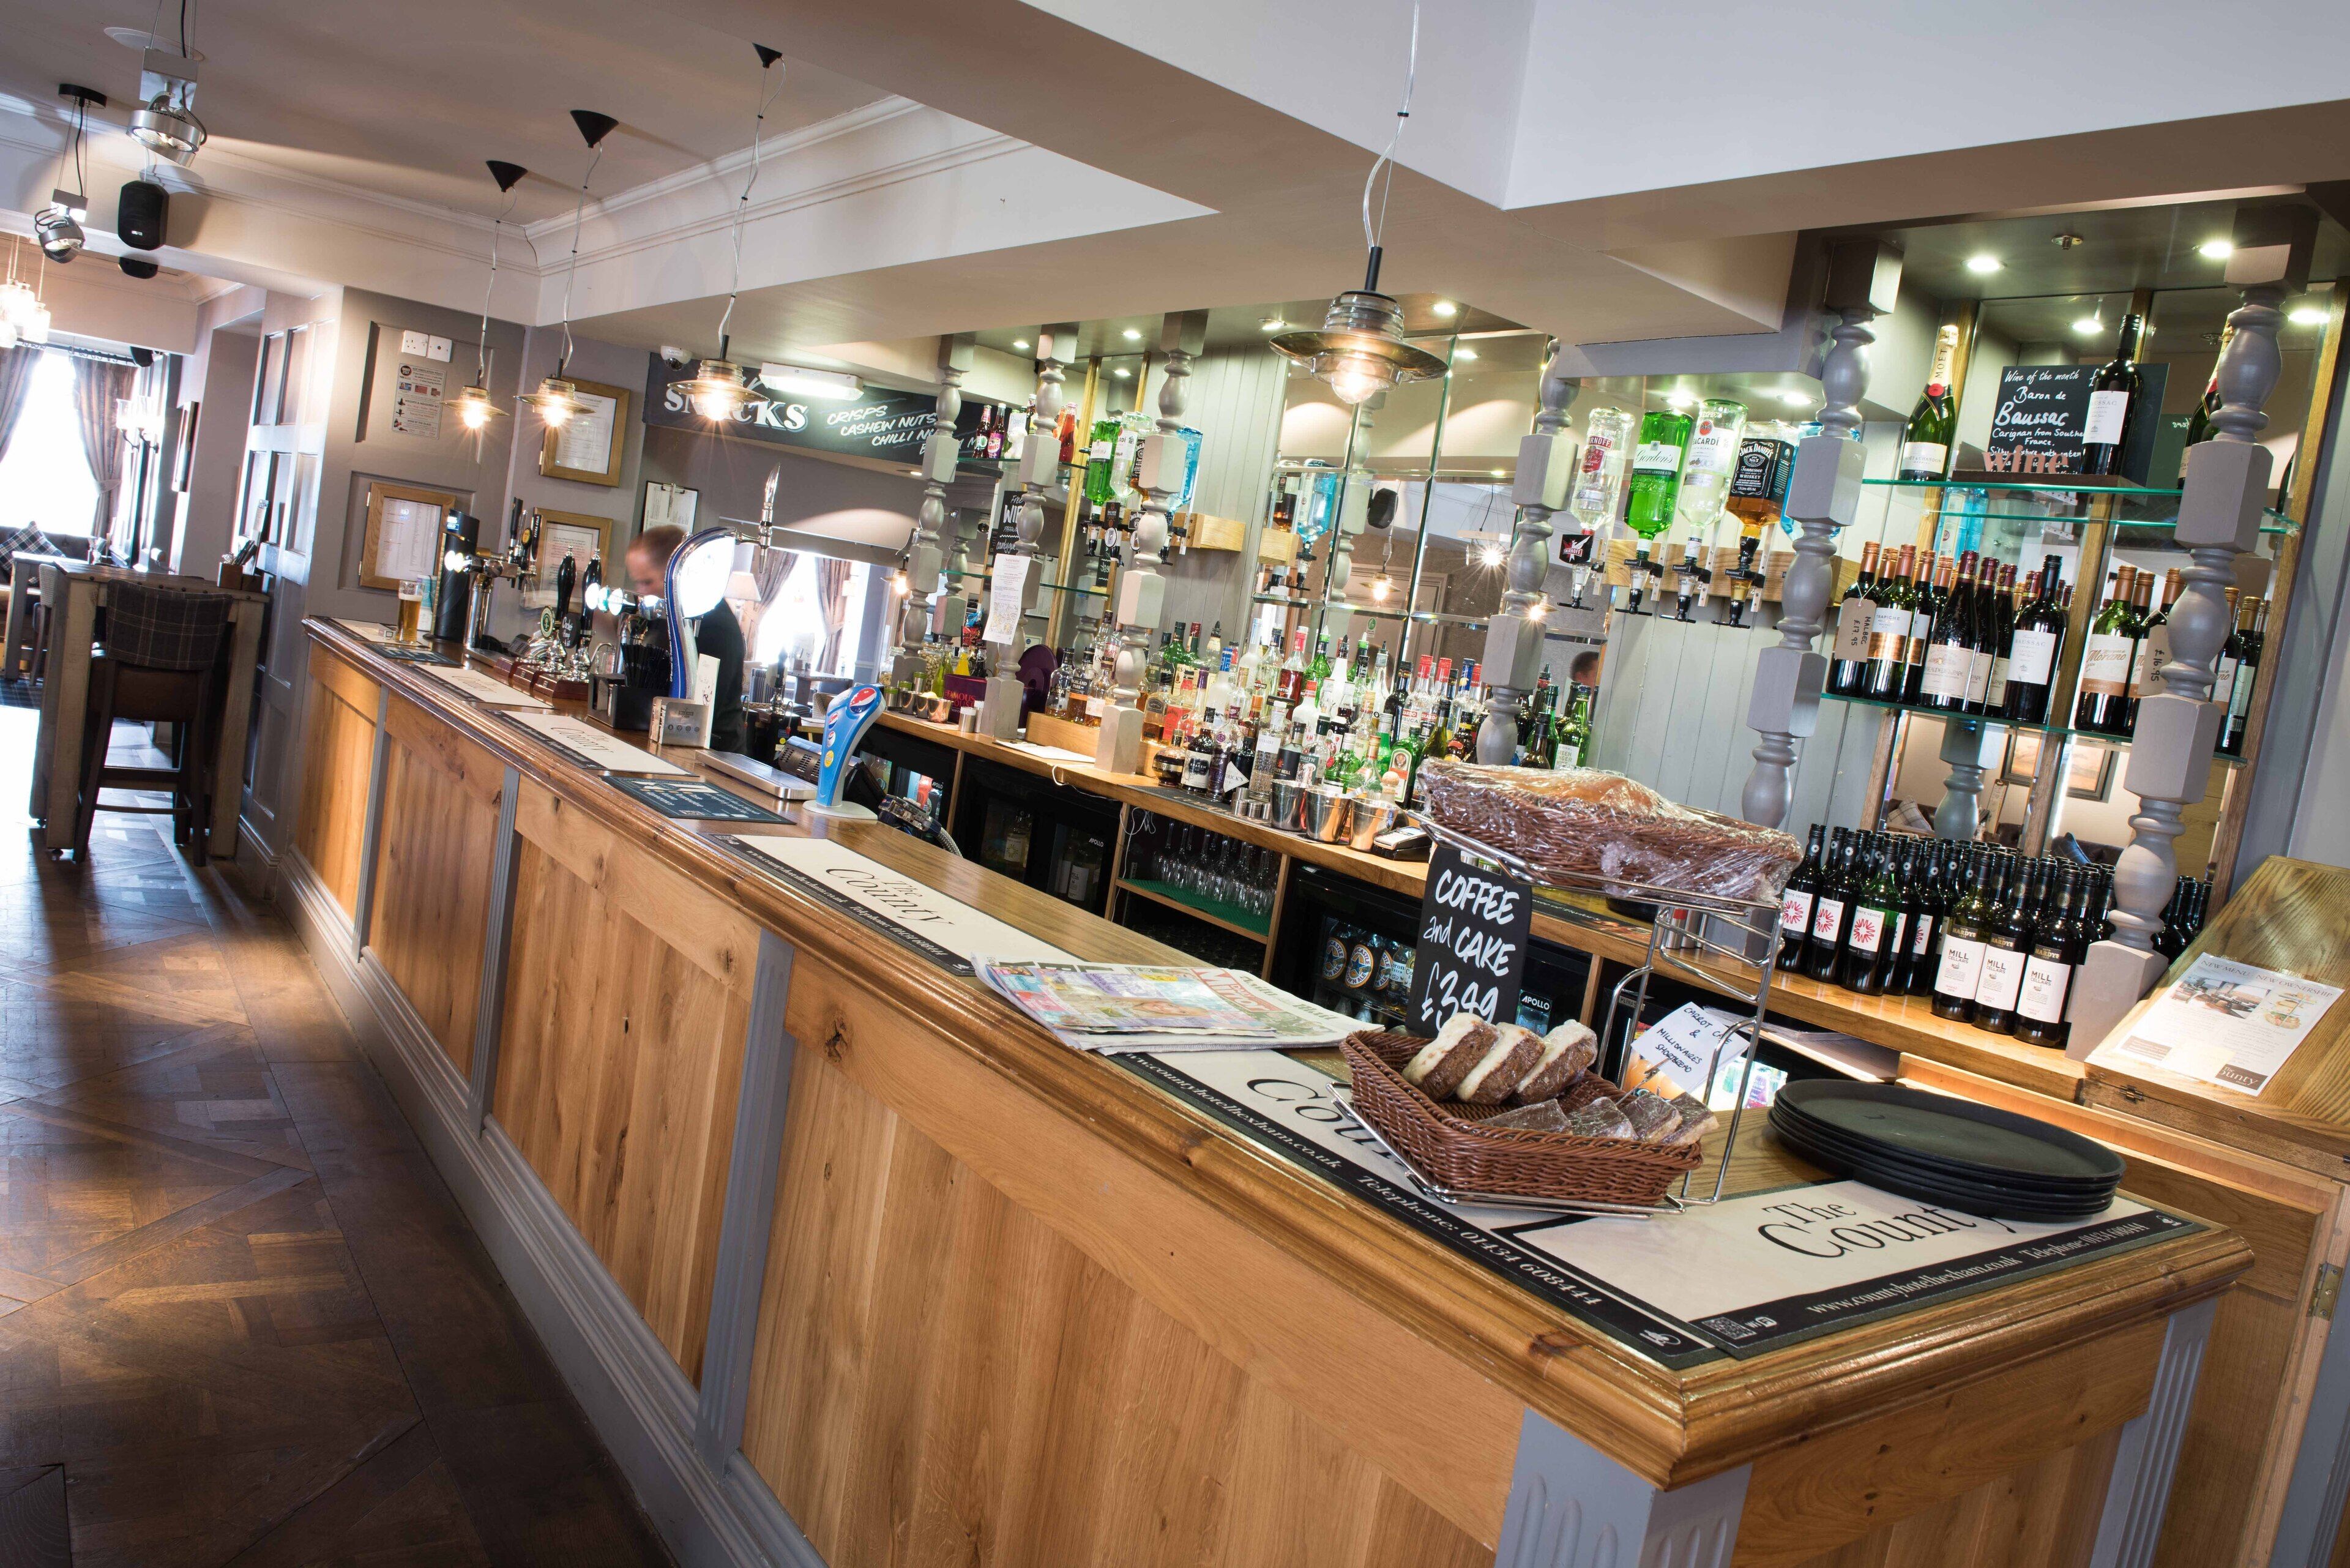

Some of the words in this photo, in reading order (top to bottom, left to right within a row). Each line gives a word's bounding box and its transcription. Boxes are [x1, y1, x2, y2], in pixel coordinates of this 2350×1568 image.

[2004, 370, 2024, 383] Wine
[2027, 369, 2039, 385] of
[2039, 370, 2053, 381] the
[2054, 369, 2080, 381] month
[2013, 386, 2050, 403] Baron
[2056, 391, 2067, 400] de
[827, 405, 888, 425] CRISPS
[1994, 401, 2070, 427] Baussac
[840, 419, 897, 436] CASHEW
[898, 413, 938, 428] NUTS
[871, 430, 914, 447] CHILLI
[1992, 428, 2032, 441] Carignan
[2034, 428, 2051, 436] from
[2054, 428, 2085, 438] Southe
[1636, 449, 1674, 464] Gordon's
[1739, 446, 1753, 457] JACK
[1982, 445, 2069, 474] wine
[1010, 495, 1023, 504] Free
[1003, 504, 1023, 523] WIF
[1851, 619, 1861, 646] £17.95
[1860, 616, 1871, 645] MALBEC
[2150, 649, 2165, 682] £16.95
[931, 781, 944, 790] APOLLO
[1225, 773, 1244, 782] DRICK'S
[1089, 837, 1105, 848] APOLLO
[826, 868, 955, 925] County
[880, 881, 923, 897] The
[1435, 868, 1520, 925] COFFEE
[1952, 927, 1977, 938] HARDYS
[1423, 916, 1453, 949] and
[1454, 927, 1516, 977] CAKE
[1991, 937, 2014, 948] HARDYS
[1948, 955, 1969, 964] CELLARS
[1949, 949, 1969, 960] MILL
[2035, 947, 2061, 959] HARDYS
[1986, 959, 2006, 970] MILL
[2201, 960, 2223, 969] NEW
[2030, 977, 2051, 986] CELLARS
[2031, 970, 2052, 982] MILL
[1521, 994, 1550, 1010] APOLLO
[1684, 1007, 1713, 1028] CARROT
[1712, 1031, 1732, 1045] CAE
[1689, 1029, 1700, 1039] &
[1657, 1028, 1703, 1064] MILLIONAIRES
[1655, 1044, 1692, 1072] SHORTBREAD
[1127, 1052, 1342, 1170] ww.countyhotelhexham.co.uk
[1357, 1176, 1459, 1231] Telephone:
[1460, 1230, 1523, 1263] 01434
[1519, 1263, 1603, 1305] 608444
[1762, 1201, 1857, 1224] The
[1758, 1203, 2018, 1260] County
[1806, 1255, 2022, 1315] www.countyhotelhexham.co.uk
[2019, 1238, 2086, 1260] Telephone:
